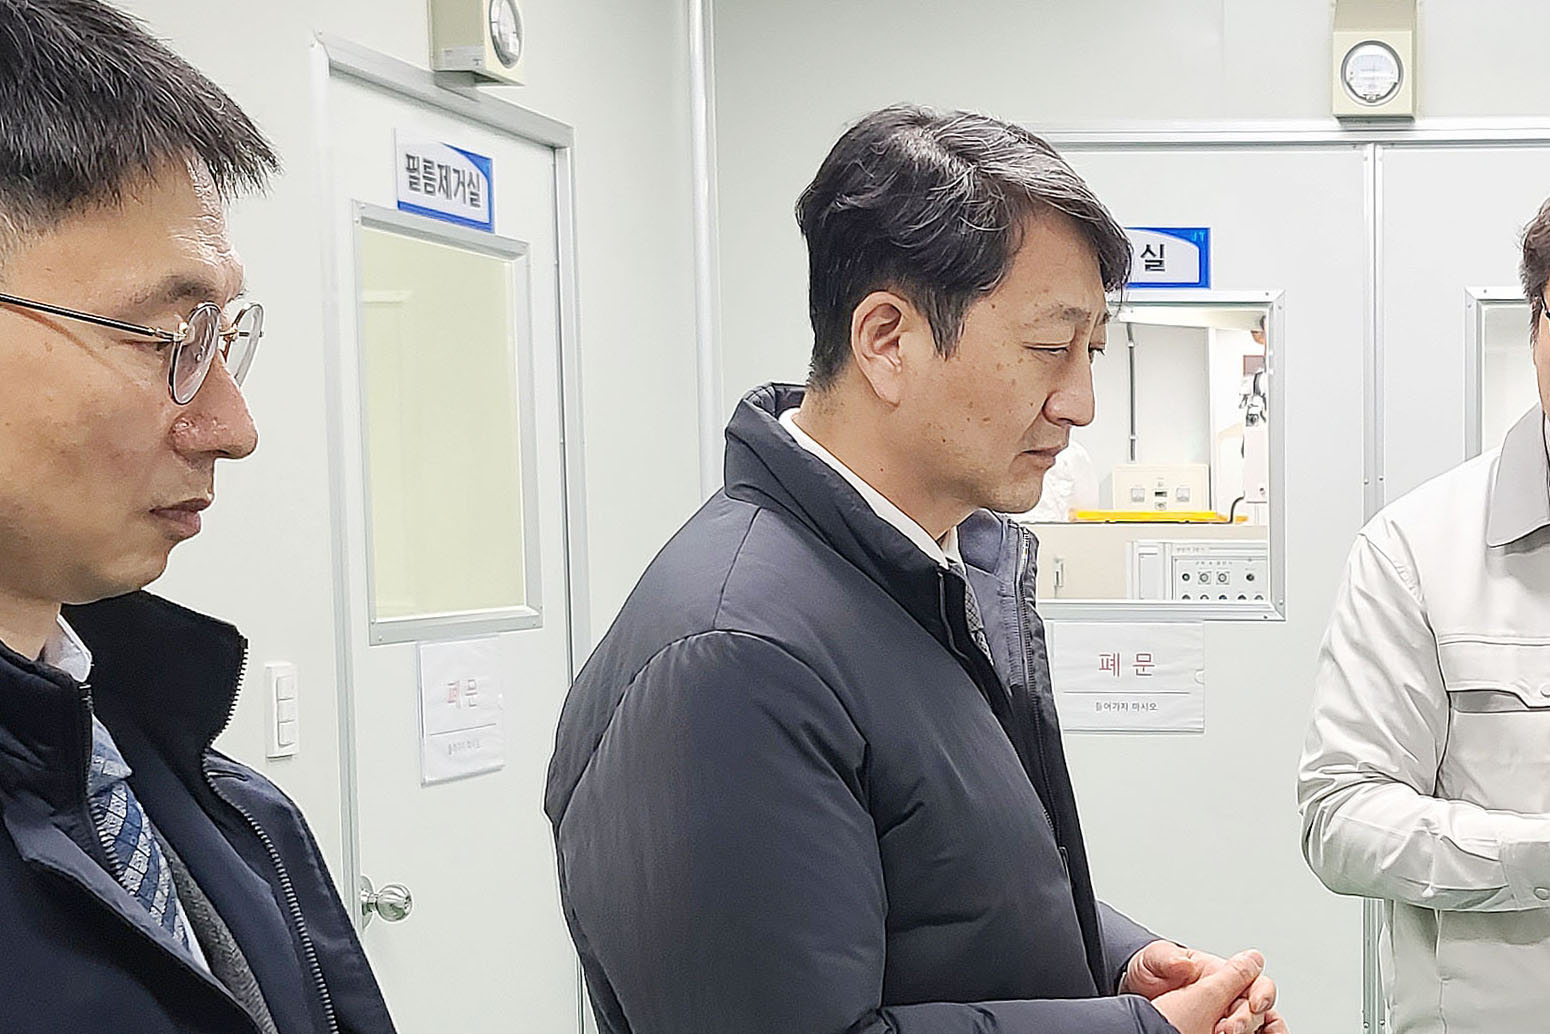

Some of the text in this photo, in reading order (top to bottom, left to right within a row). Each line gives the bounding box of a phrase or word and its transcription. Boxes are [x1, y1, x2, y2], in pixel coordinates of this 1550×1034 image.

[405, 153, 481, 208] 필름제거실
[1140, 243, 1166, 272] 실
[1132, 653, 1155, 677] 문
